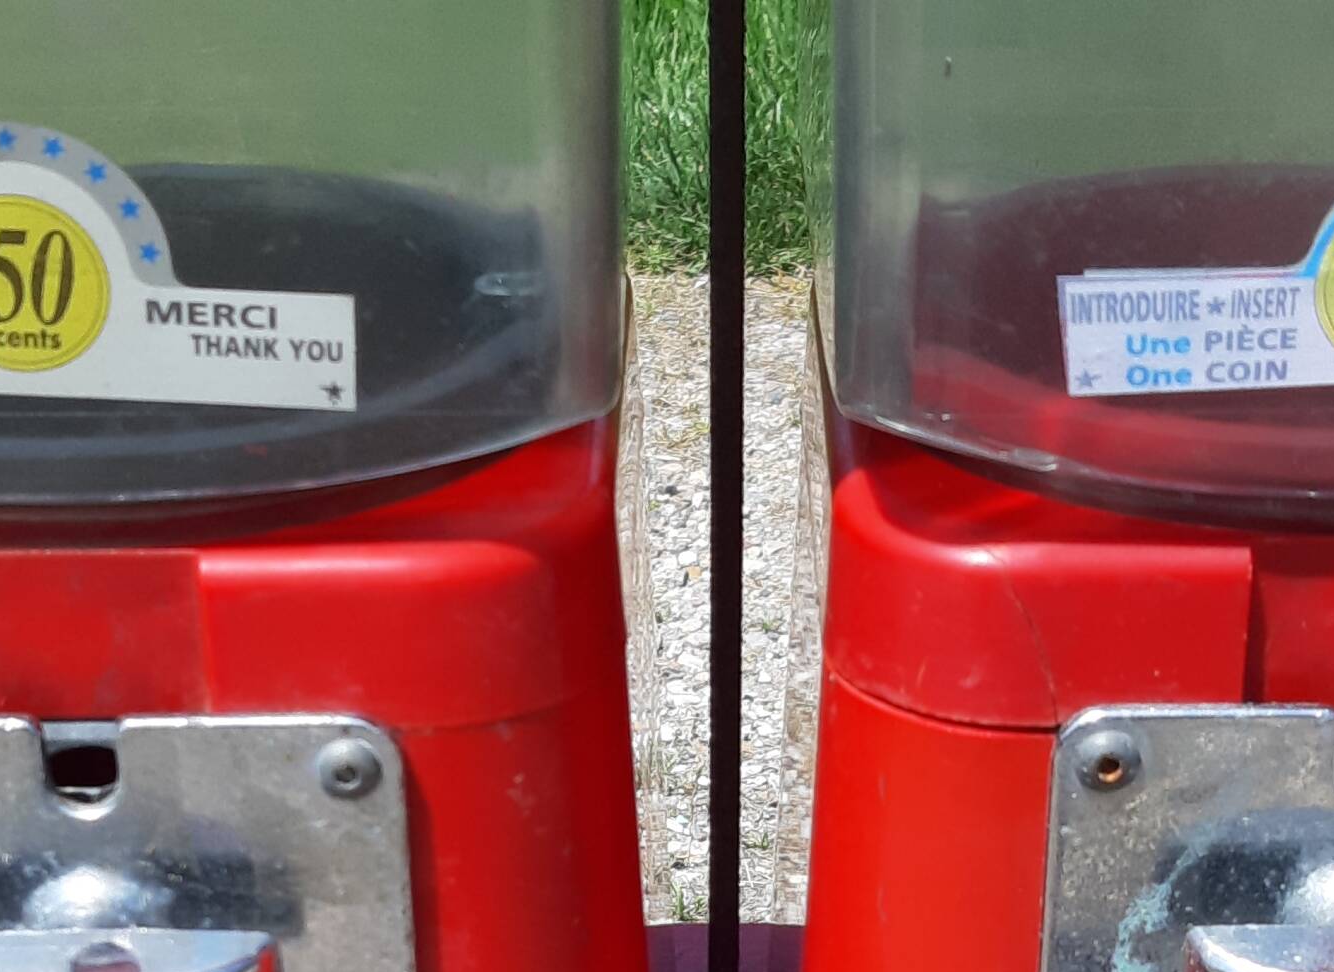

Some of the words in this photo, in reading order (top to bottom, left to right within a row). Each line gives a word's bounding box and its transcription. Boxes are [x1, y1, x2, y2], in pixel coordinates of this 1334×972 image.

[144, 300, 278, 331] MERCI
[1069, 290, 1201, 325] INTRODUIRE
[1229, 287, 1301, 320] INSERT
[191, 334, 279, 360] THANK
[289, 336, 343, 362] YOU
[1126, 332, 1192, 357] Une
[1204, 324, 1297, 353] PIÈCE
[1125, 362, 1193, 387] One
[1205, 360, 1287, 383] COIN
